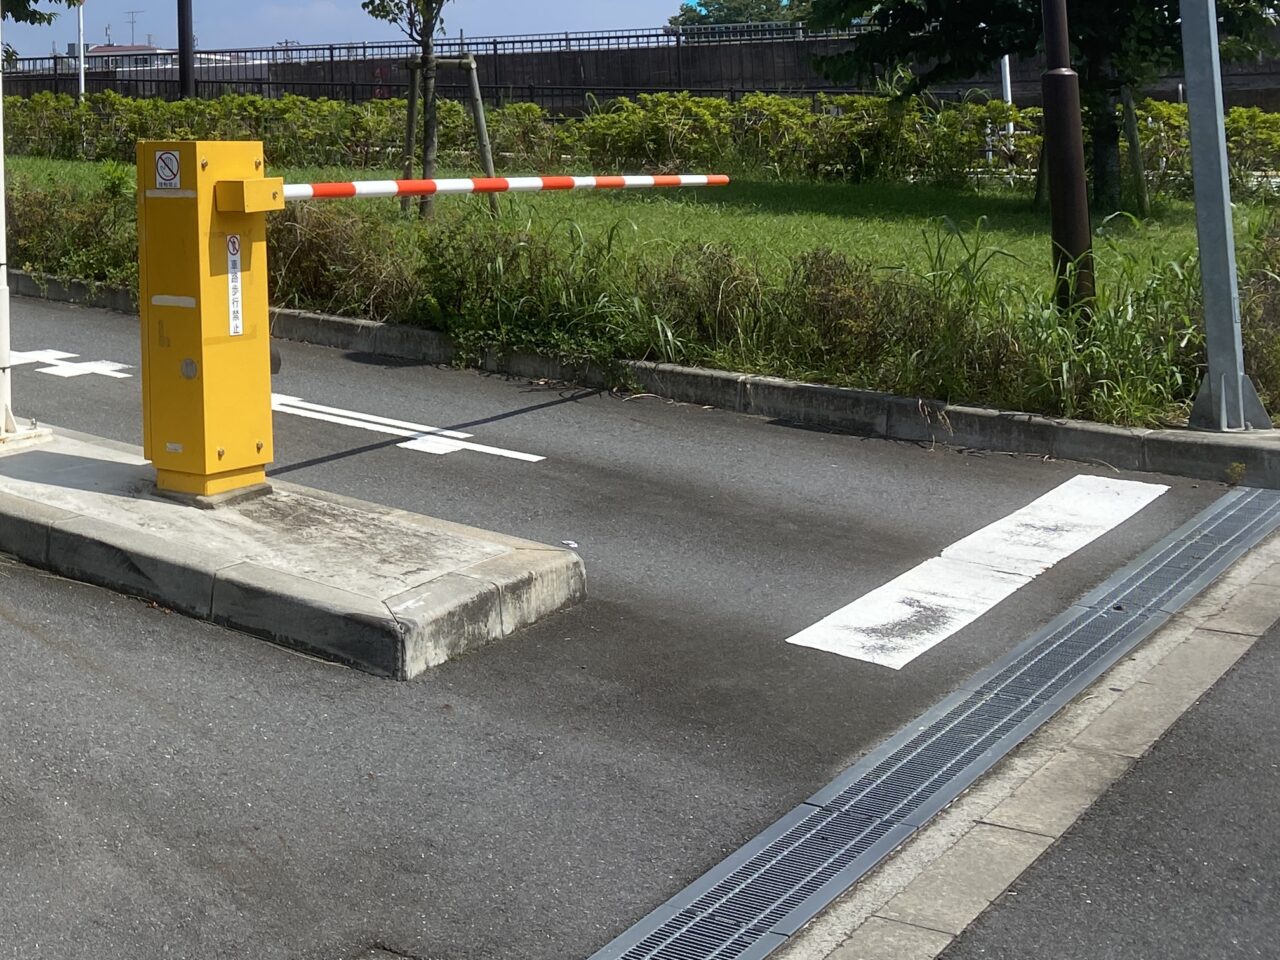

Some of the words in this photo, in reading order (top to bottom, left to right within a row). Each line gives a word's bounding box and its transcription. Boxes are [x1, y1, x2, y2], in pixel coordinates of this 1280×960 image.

[231, 259, 241, 334] 車路歩行禁止
